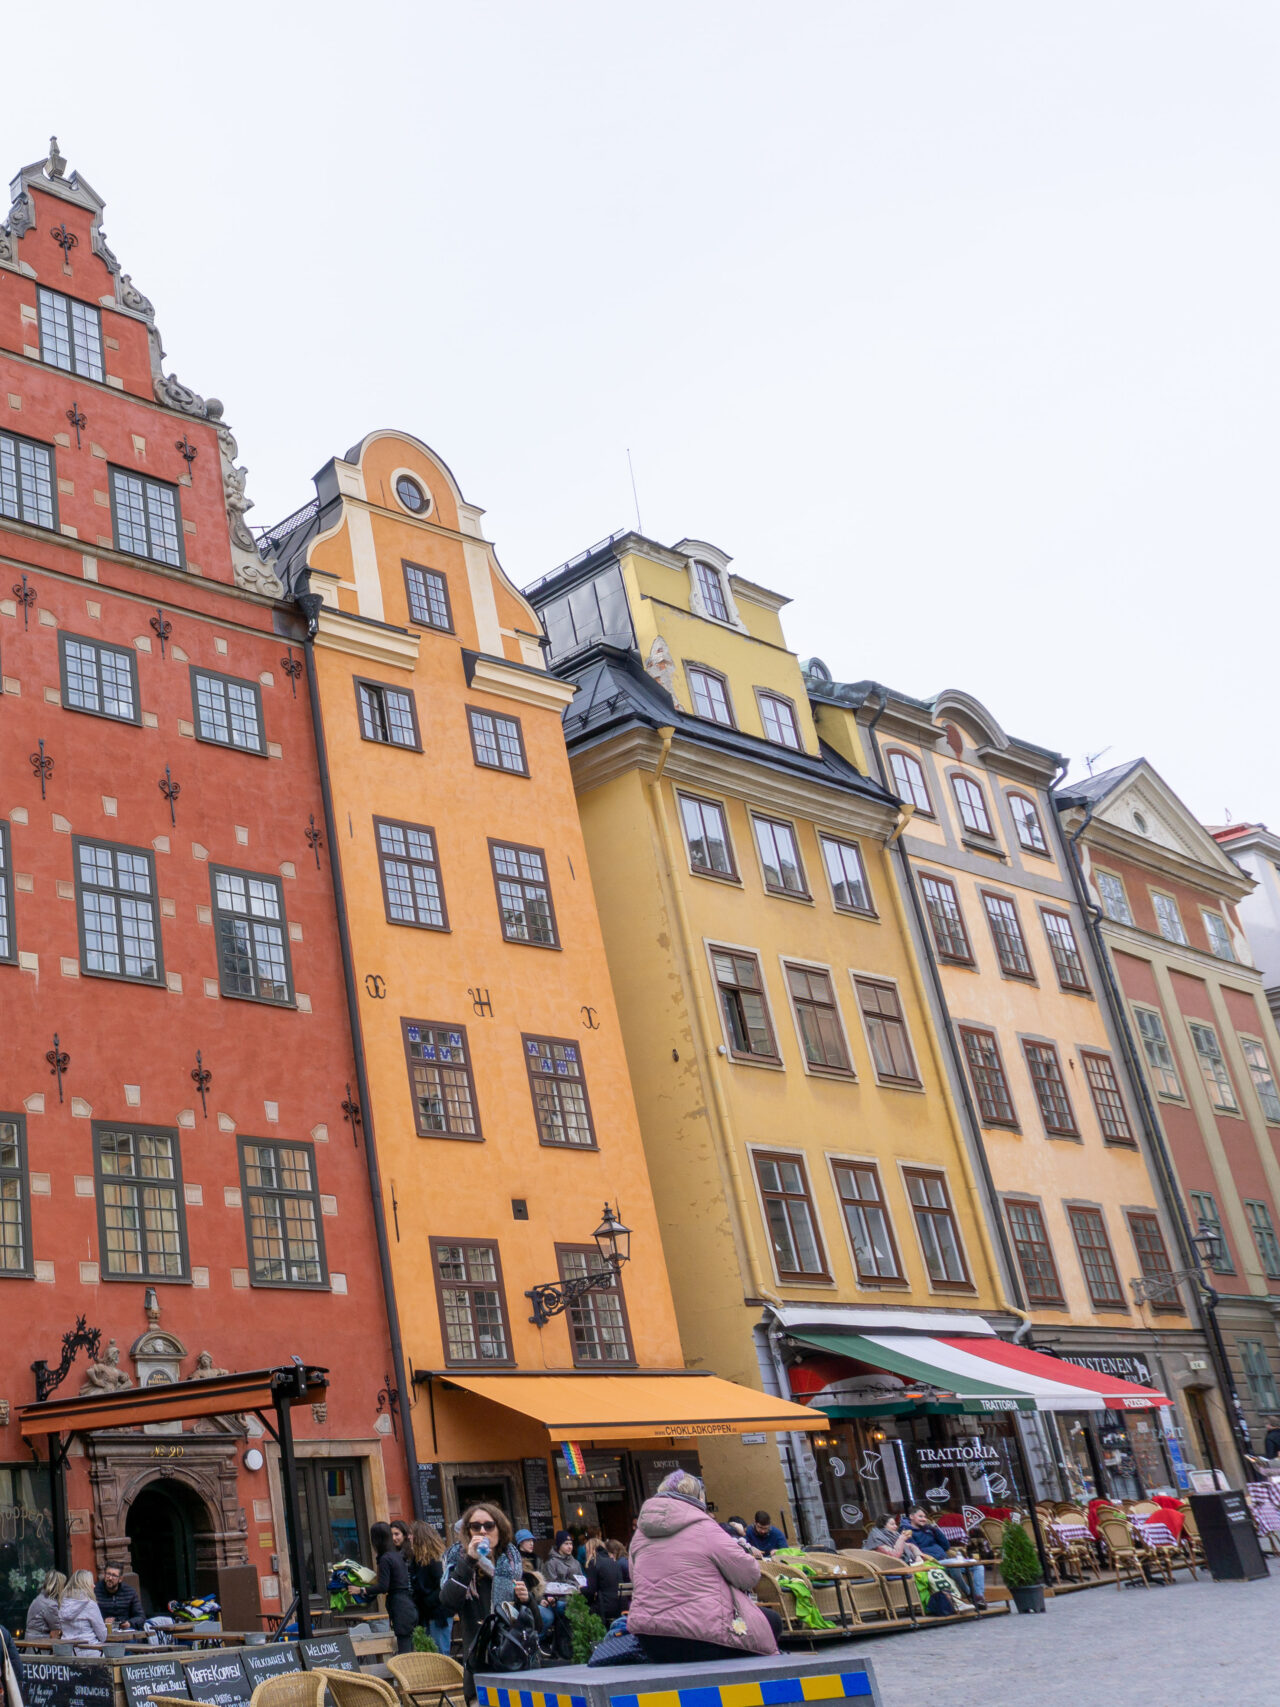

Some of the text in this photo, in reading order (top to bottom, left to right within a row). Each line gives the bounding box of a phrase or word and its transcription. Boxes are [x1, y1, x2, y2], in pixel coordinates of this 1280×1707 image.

[980, 1400, 1019, 1410] TRATTORIA
[169, 1446, 184, 1458] 20
[917, 1446, 999, 1461] TRATTORIA
[305, 1642, 340, 1656] WELCOME
